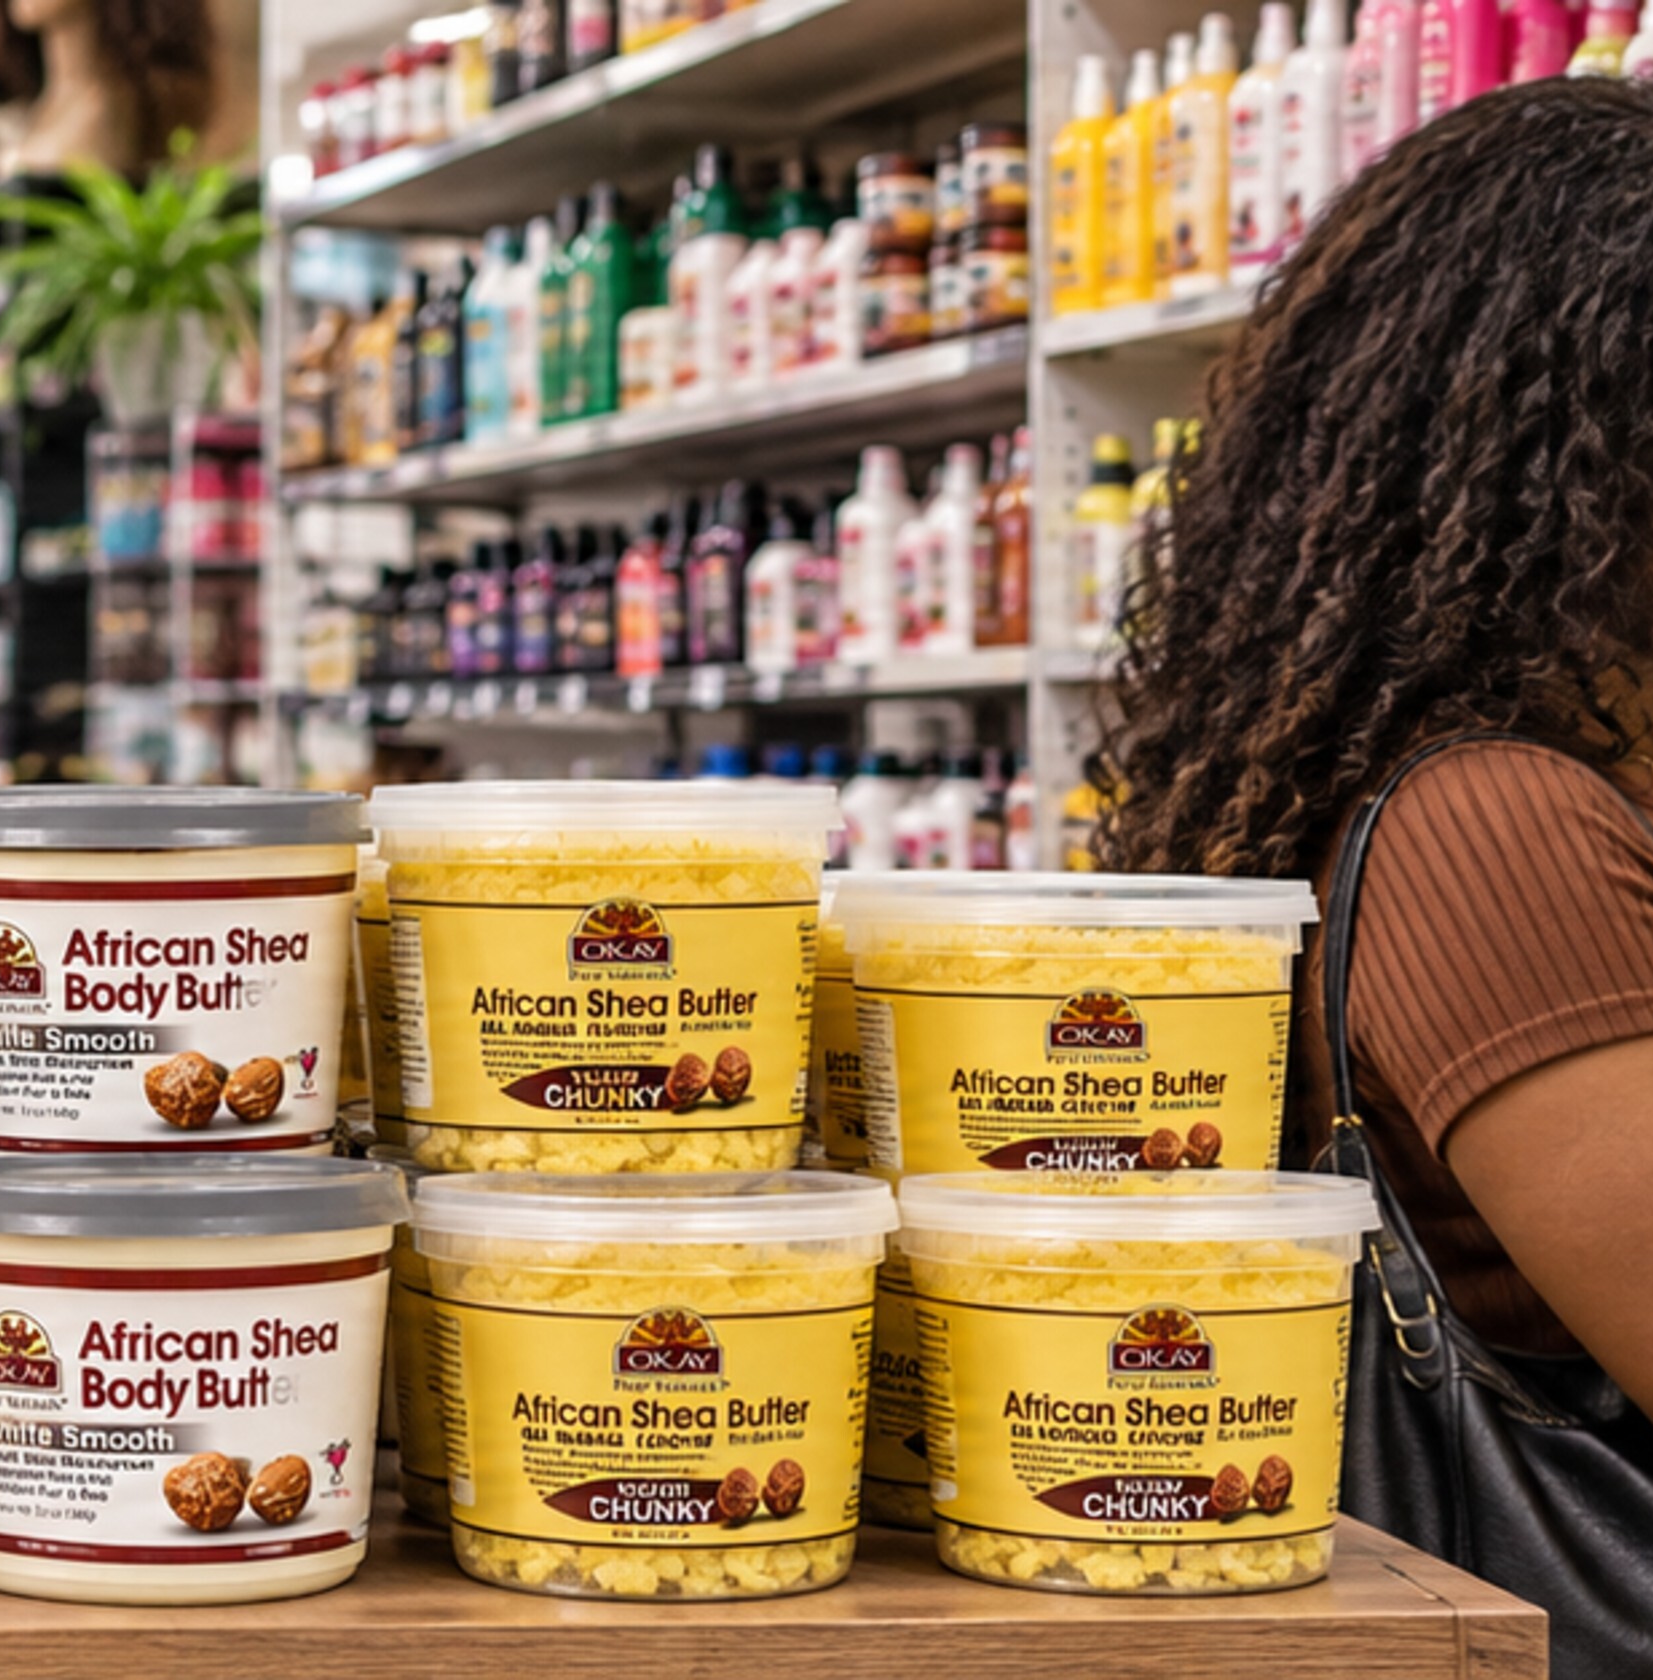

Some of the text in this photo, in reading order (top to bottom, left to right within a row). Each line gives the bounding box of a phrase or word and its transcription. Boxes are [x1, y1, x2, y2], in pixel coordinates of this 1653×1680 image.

[62, 927, 311, 967] African Shea
[581, 939, 661, 959] OKAY
[64, 973, 169, 1020] Body
[471, 986, 758, 1020] African Shea Butter
[45, 1027, 156, 1052] Smooth
[1056, 1025, 1135, 1045] OKAY
[543, 1083, 666, 1110] CHUNKY
[949, 1068, 1227, 1098] African Shea Butter
[1025, 1149, 1140, 1171] CHUNKY
[78, 1319, 338, 1362] African Shea
[626, 1349, 712, 1369] OKAY
[1118, 1346, 1205, 1368] OKAY
[80, 1368, 190, 1419] Body
[512, 1393, 810, 1430] African Shea Butter
[1003, 1391, 1298, 1426] African Shea Butter
[62, 1424, 175, 1452] Smooth
[588, 1496, 716, 1524] CHUNKY
[1082, 1493, 1209, 1521] CHUNKY
